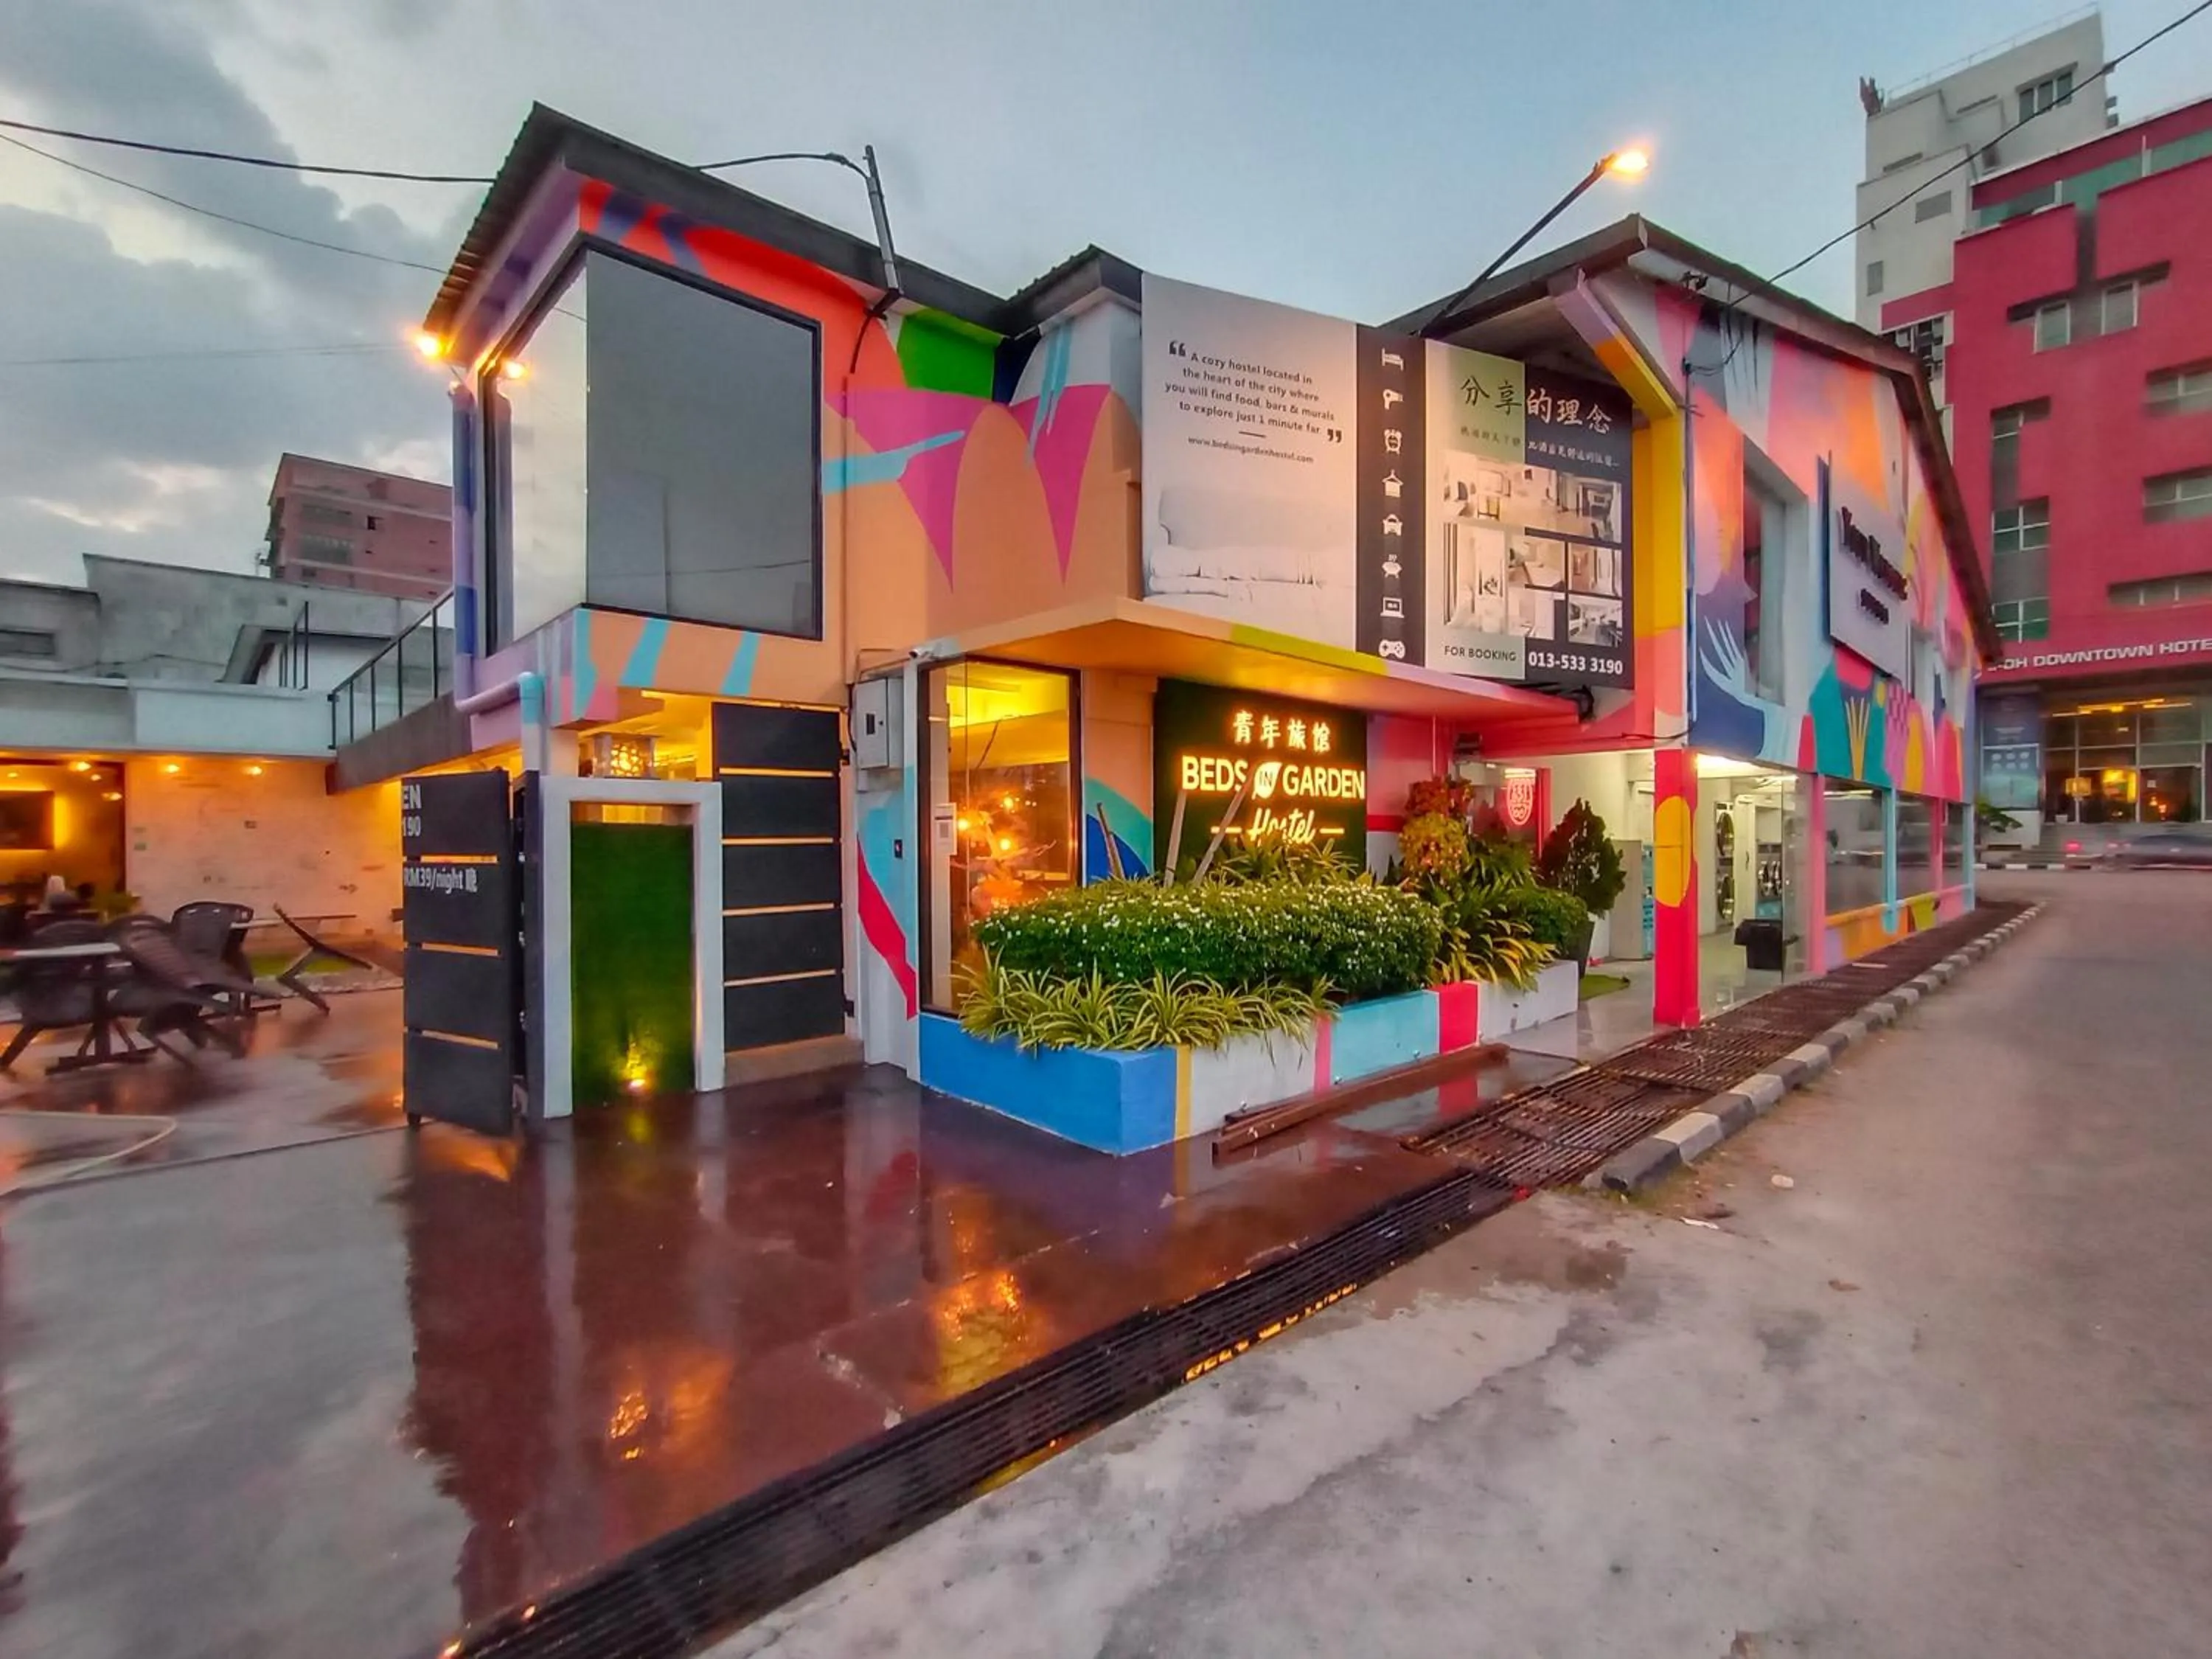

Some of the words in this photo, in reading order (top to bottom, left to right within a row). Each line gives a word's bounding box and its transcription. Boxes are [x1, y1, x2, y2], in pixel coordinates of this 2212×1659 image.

[1183, 367, 1200, 380] the
[1203, 370, 1231, 386] heart
[1235, 377, 1245, 388] of
[1248, 380, 1265, 392] the
[1267, 384, 1287, 398] city
[1290, 390, 1319, 402] where
[1201, 356, 1225, 369] cozy
[1228, 358, 1260, 374] hostel
[1263, 366, 1300, 383] located
[1303, 376, 1312, 384] in
[1165, 381, 1185, 393] you
[1189, 386, 1208, 397] will
[1211, 388, 1232, 402] find
[1266, 399, 1287, 412] bars
[1290, 406, 1298, 414] &
[1301, 408, 1335, 421] murals
[1180, 400, 1191, 411] to
[1194, 405, 1234, 418] explore
[1236, 411, 1256, 422] just
[1259, 414, 1265, 424] 1
[1267, 417, 1303, 431] minute
[1461, 375, 1613, 435] 分享的理念
[1444, 645, 1466, 657] FOR
[1468, 647, 1517, 662] BOOKING
[1528, 651, 1587, 672] 013-533
[1589, 657, 1624, 676] 3190
[1987, 655, 2028, 672] OH
[2033, 644, 2154, 667] DOWNTOWN
[1182, 755, 1248, 792] BEDS
[1282, 765, 1366, 799] GARDEN
